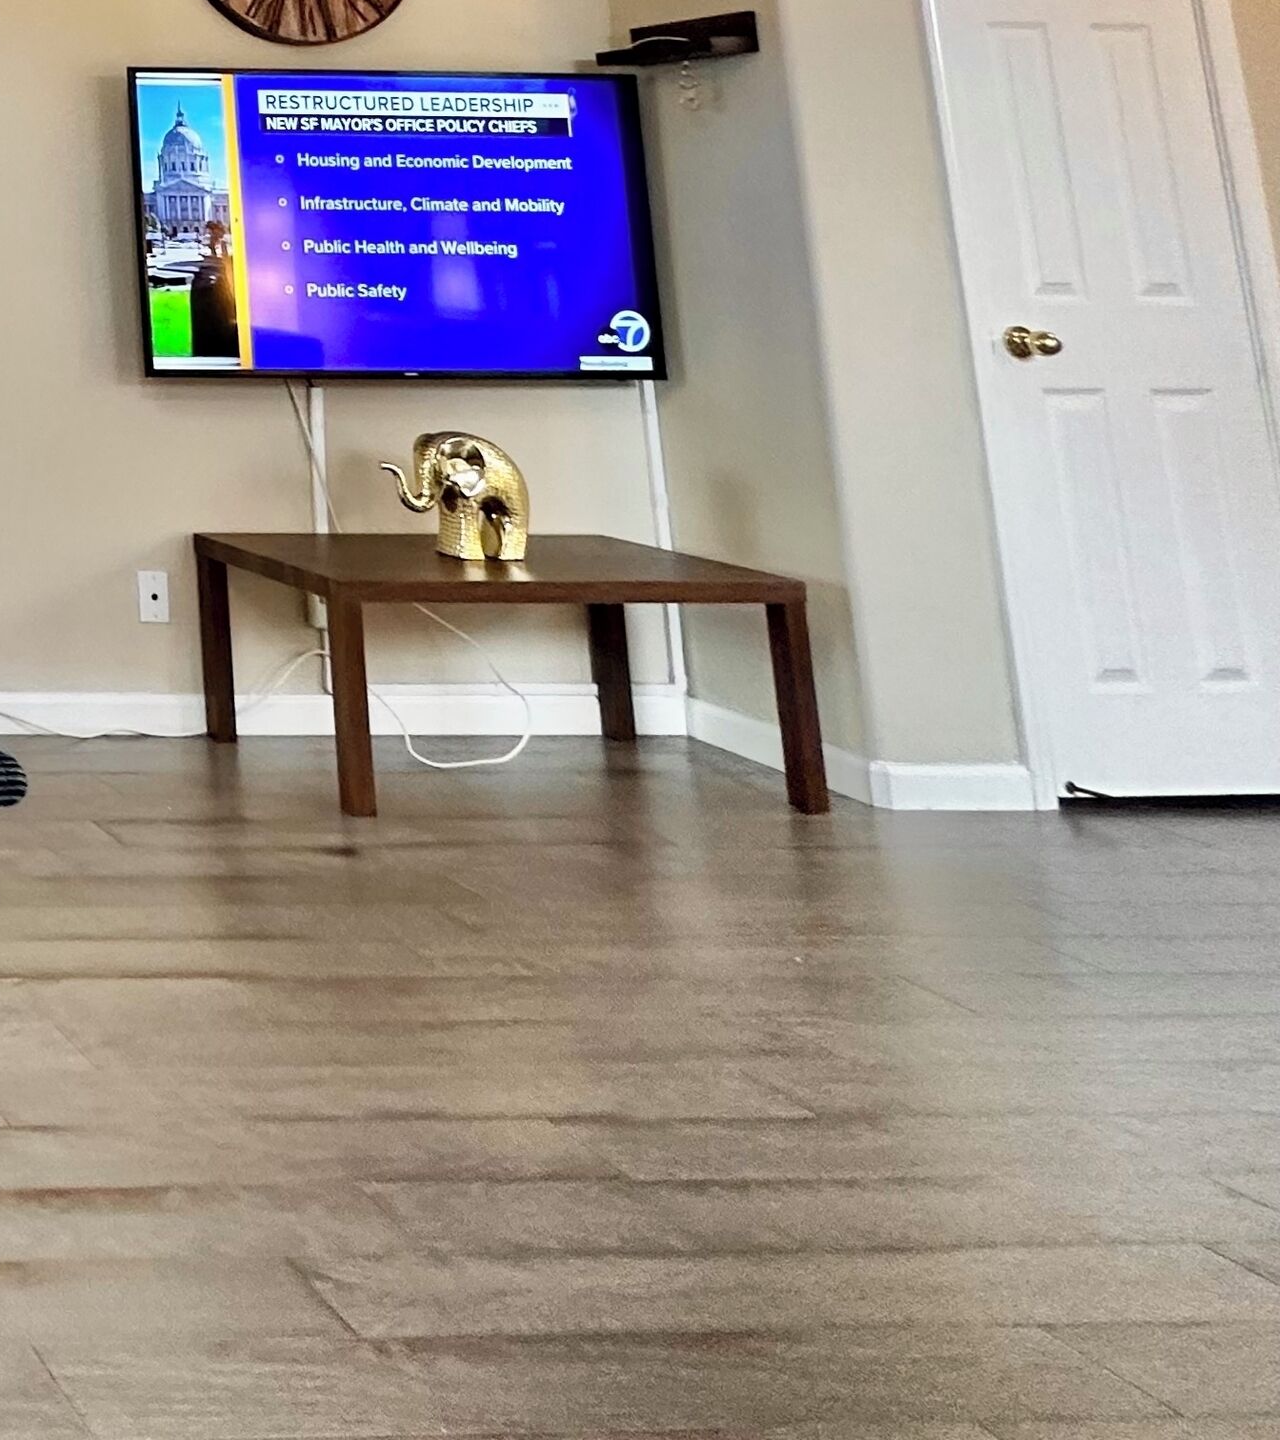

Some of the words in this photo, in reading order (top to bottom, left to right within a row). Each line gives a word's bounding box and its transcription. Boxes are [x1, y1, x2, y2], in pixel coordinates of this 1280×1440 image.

[265, 94, 414, 111] RESTRUCTURED
[420, 96, 534, 113] LEADERSHIP
[265, 116, 298, 131] NEW
[300, 116, 319, 131] SF
[320, 117, 383, 132] MAYOR'S
[385, 118, 435, 133] OFFICE
[436, 119, 486, 133] POLICY
[487, 119, 537, 135] CHIEFS
[297, 153, 360, 170] Housing
[364, 154, 391, 168] and
[396, 154, 469, 169] Economic
[472, 155, 573, 172] Development
[300, 195, 407, 212] Infrastructure,
[410, 196, 468, 211] Climate
[472, 198, 500, 212] and
[504, 198, 565, 216] Mobility
[303, 239, 351, 254] Public
[354, 240, 405, 254] Health
[409, 241, 438, 255] and
[440, 241, 518, 258] Wellbeing
[306, 283, 354, 298] Public
[357, 284, 407, 301] Safety
